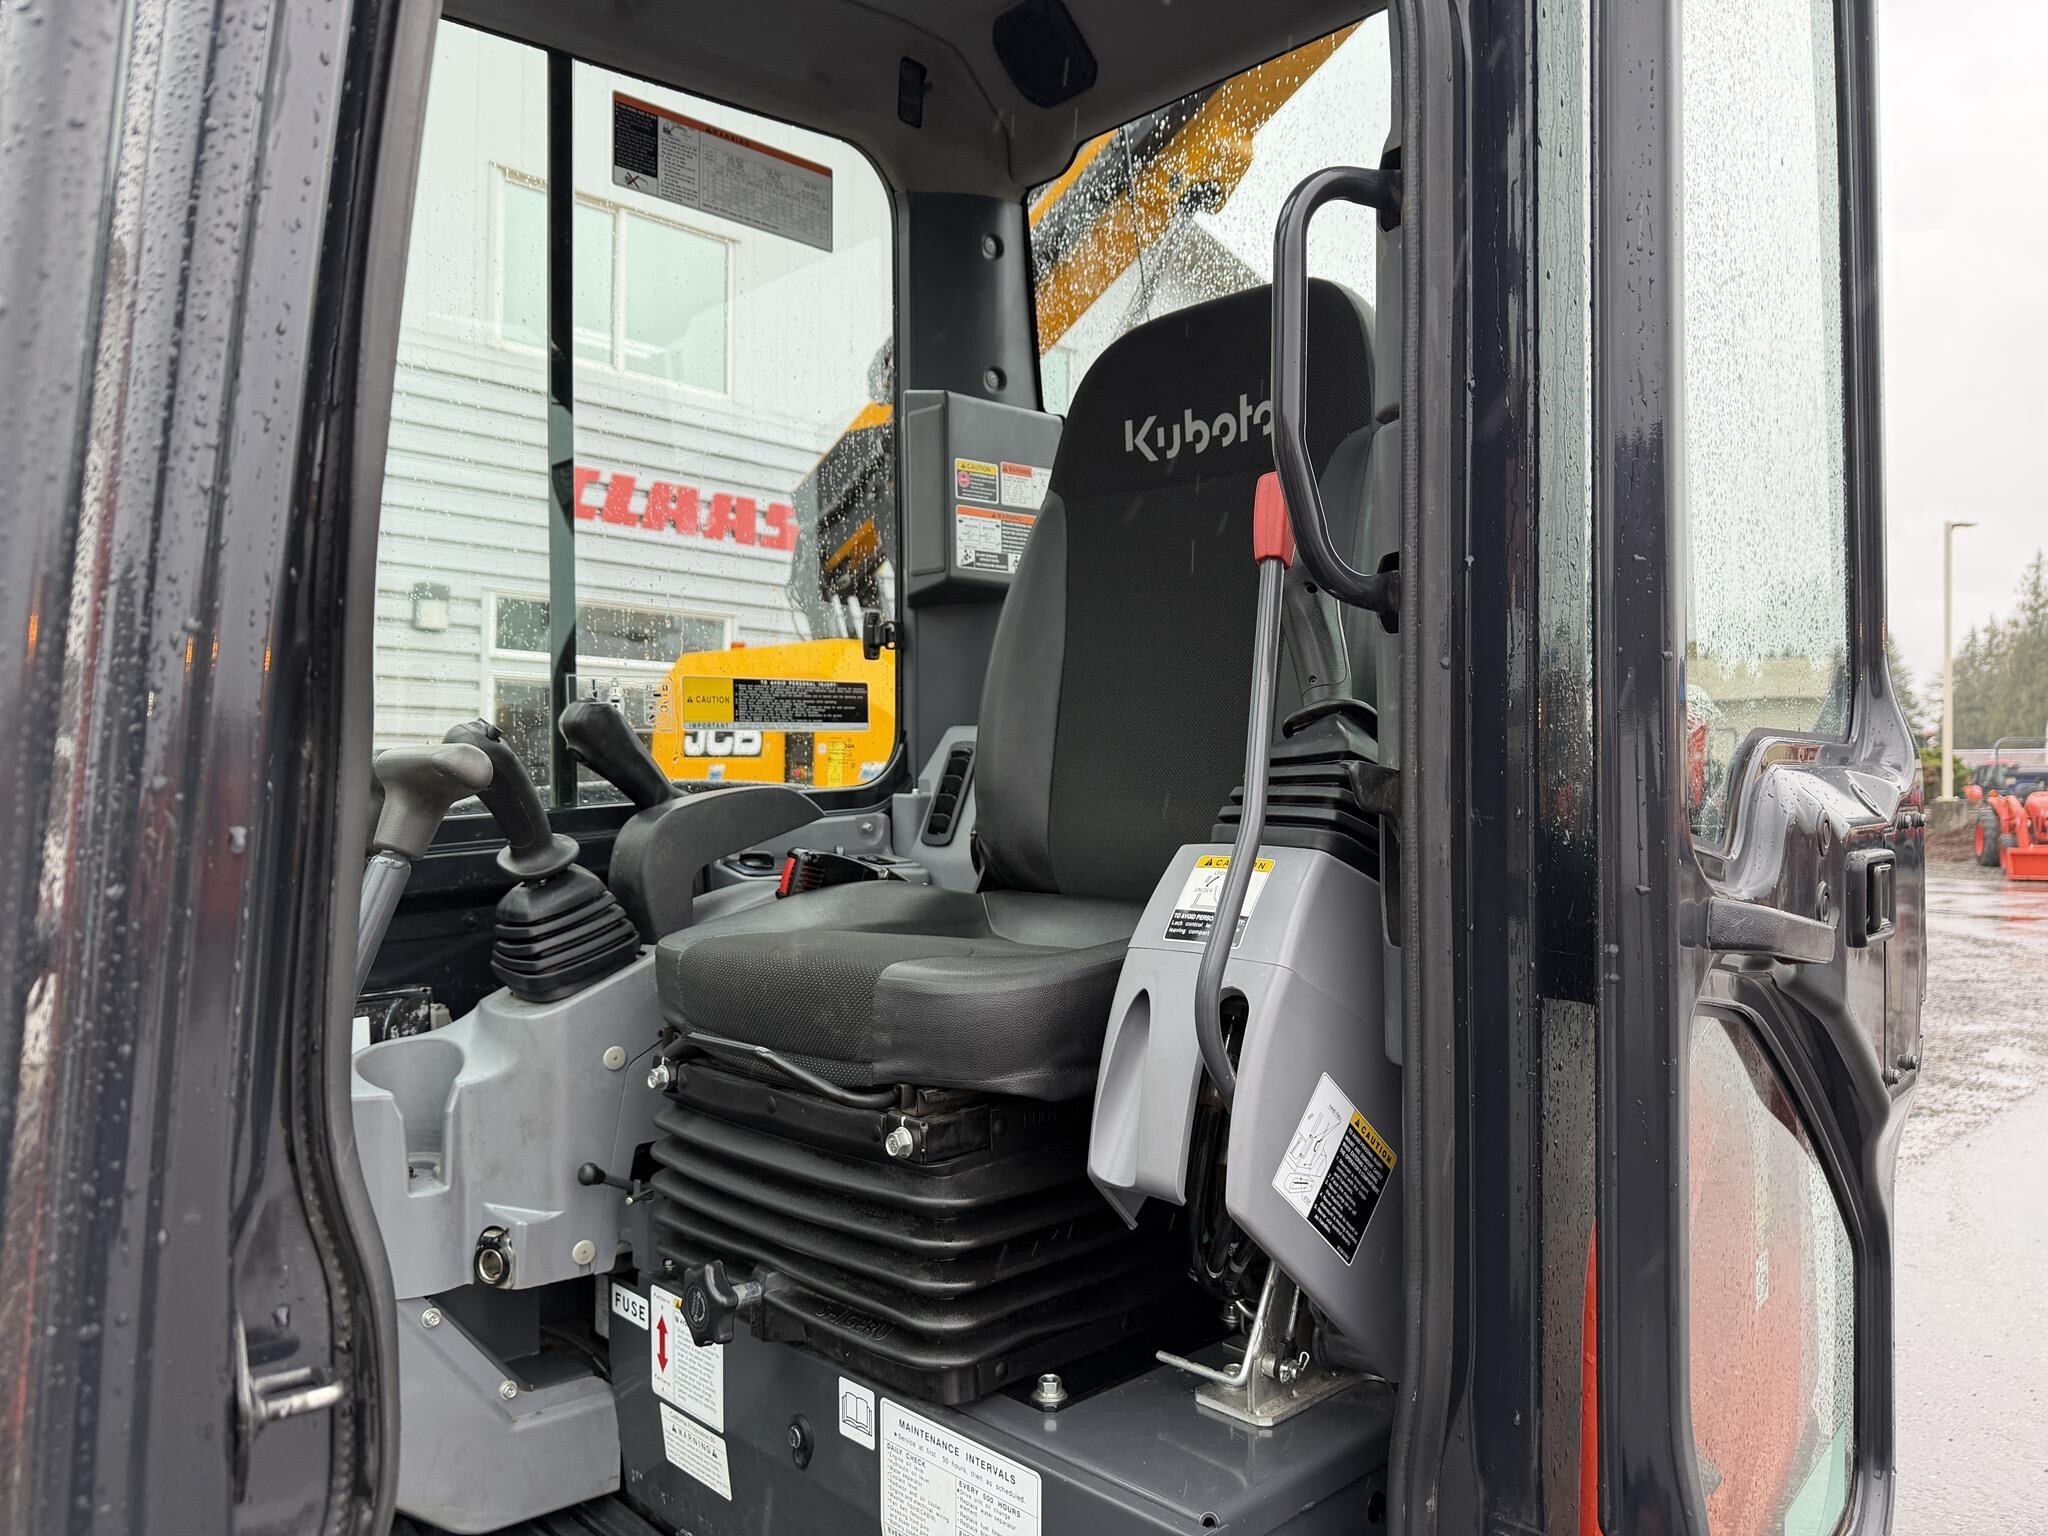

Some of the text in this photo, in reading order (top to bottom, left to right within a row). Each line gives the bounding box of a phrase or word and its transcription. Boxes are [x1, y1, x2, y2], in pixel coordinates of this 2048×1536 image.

[967, 464, 992, 472] CAUTION
[574, 467, 800, 552] CLAAS
[1362, 1126, 1391, 1164] CAUTION
[616, 1292, 645, 1322] FUSE
[678, 1430, 711, 1454] WARNING
[887, 1442, 926, 1468] DAILY CHECK
[898, 1434, 916, 1448] Service
[971, 1470, 982, 1482] then
[986, 1479, 992, 1487] as
[899, 1419, 1016, 1484] MAINTENANCE INTERVALS
[959, 1481, 1021, 1518] EVERY 500 HOURS
